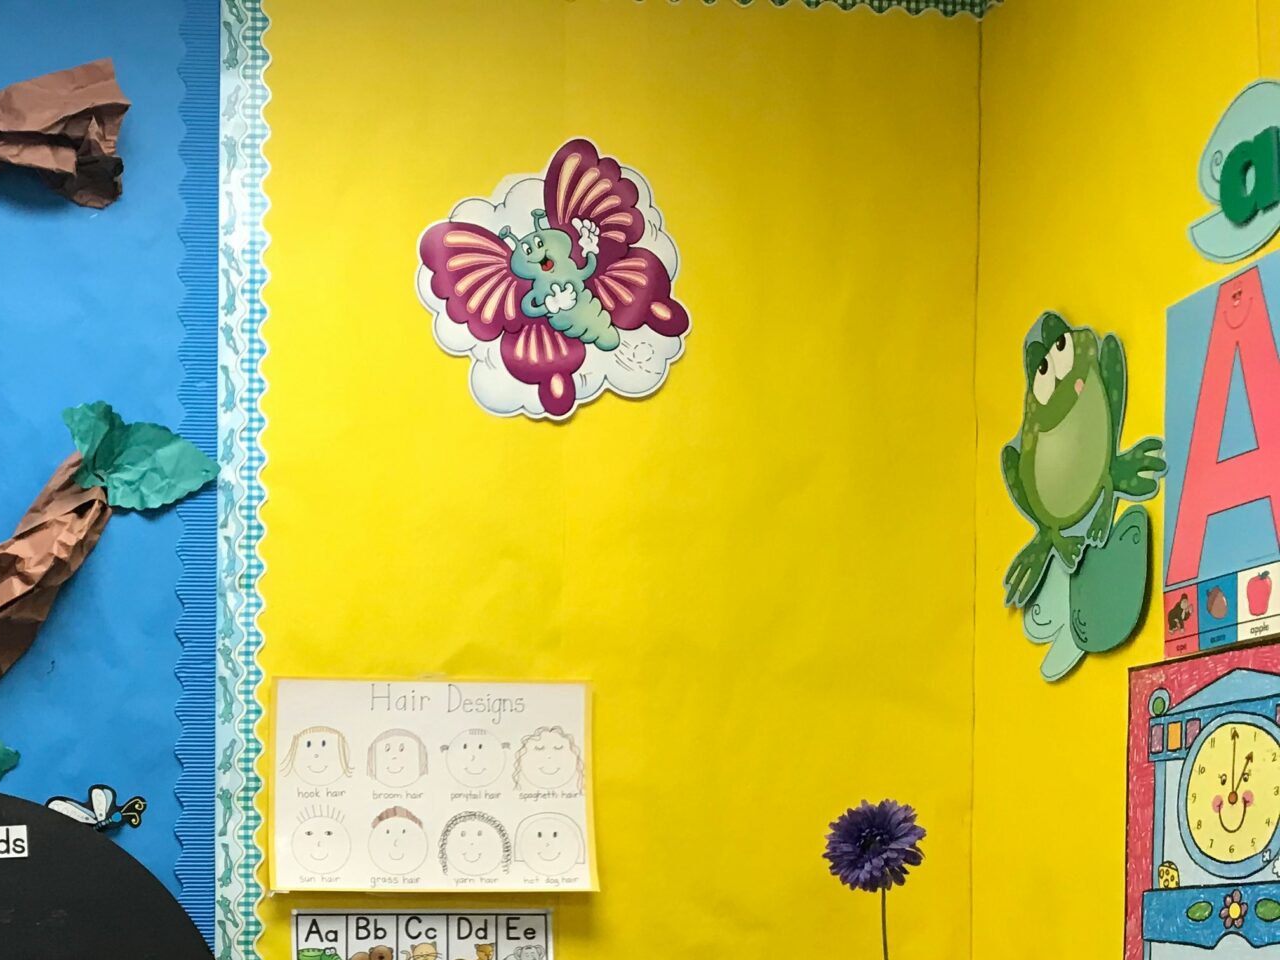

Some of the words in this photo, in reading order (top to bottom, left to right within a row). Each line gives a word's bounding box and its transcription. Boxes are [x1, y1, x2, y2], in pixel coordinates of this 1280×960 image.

[1220, 126, 1280, 226] a
[1250, 622, 1269, 636] apple
[370, 683, 430, 712] Hair
[447, 683, 525, 725] Designs
[1272, 753, 1277, 762] 2
[1198, 765, 1205, 775] 10
[297, 788, 320, 798] hook
[326, 788, 346, 798] hair
[372, 790, 402, 800] broom
[406, 791, 424, 799] hair
[484, 791, 501, 800] hair
[561, 791, 579, 799] hair
[1192, 793, 1196, 803] 9
[1196, 820, 1202, 830] 8
[1251, 838, 1256, 846] 5
[1229, 845, 1234, 853] 6
[370, 876, 399, 888] grass
[402, 876, 421, 884] hair
[480, 876, 498, 884] hair
[305, 919, 339, 943] Aa
[356, 918, 387, 940] Bb
[405, 917, 438, 940] Cc
[457, 918, 488, 940] Dd
[506, 917, 536, 939] Ee
